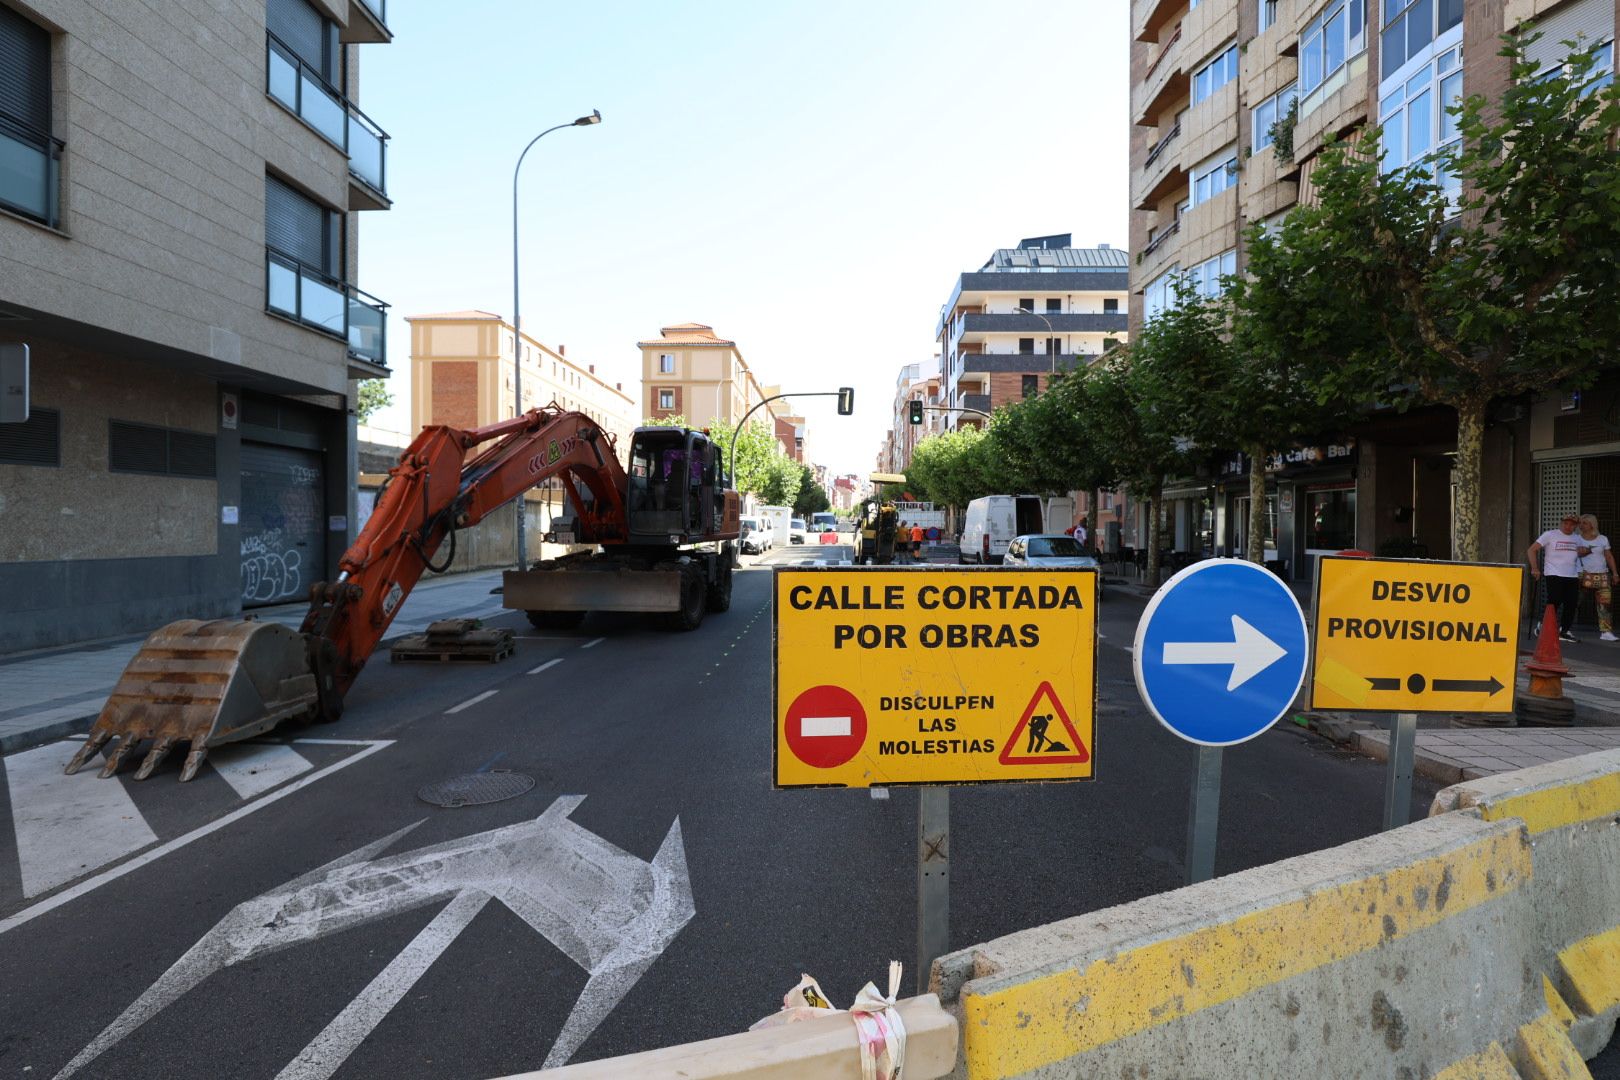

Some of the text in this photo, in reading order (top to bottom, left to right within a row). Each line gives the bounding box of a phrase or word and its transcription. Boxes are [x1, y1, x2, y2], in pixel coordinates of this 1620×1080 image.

[1327, 445, 1353, 458] Bar
[789, 585, 1083, 611] CALLE CORTADA
[1371, 580, 1471, 604] DESVIO
[834, 623, 1040, 649] POR OBRAS
[1327, 617, 1507, 644] PROVISIONAL
[880, 695, 995, 711] DISCULPEN
[918, 718, 957, 732] LAS
[879, 739, 995, 755] MOLESTIAS
